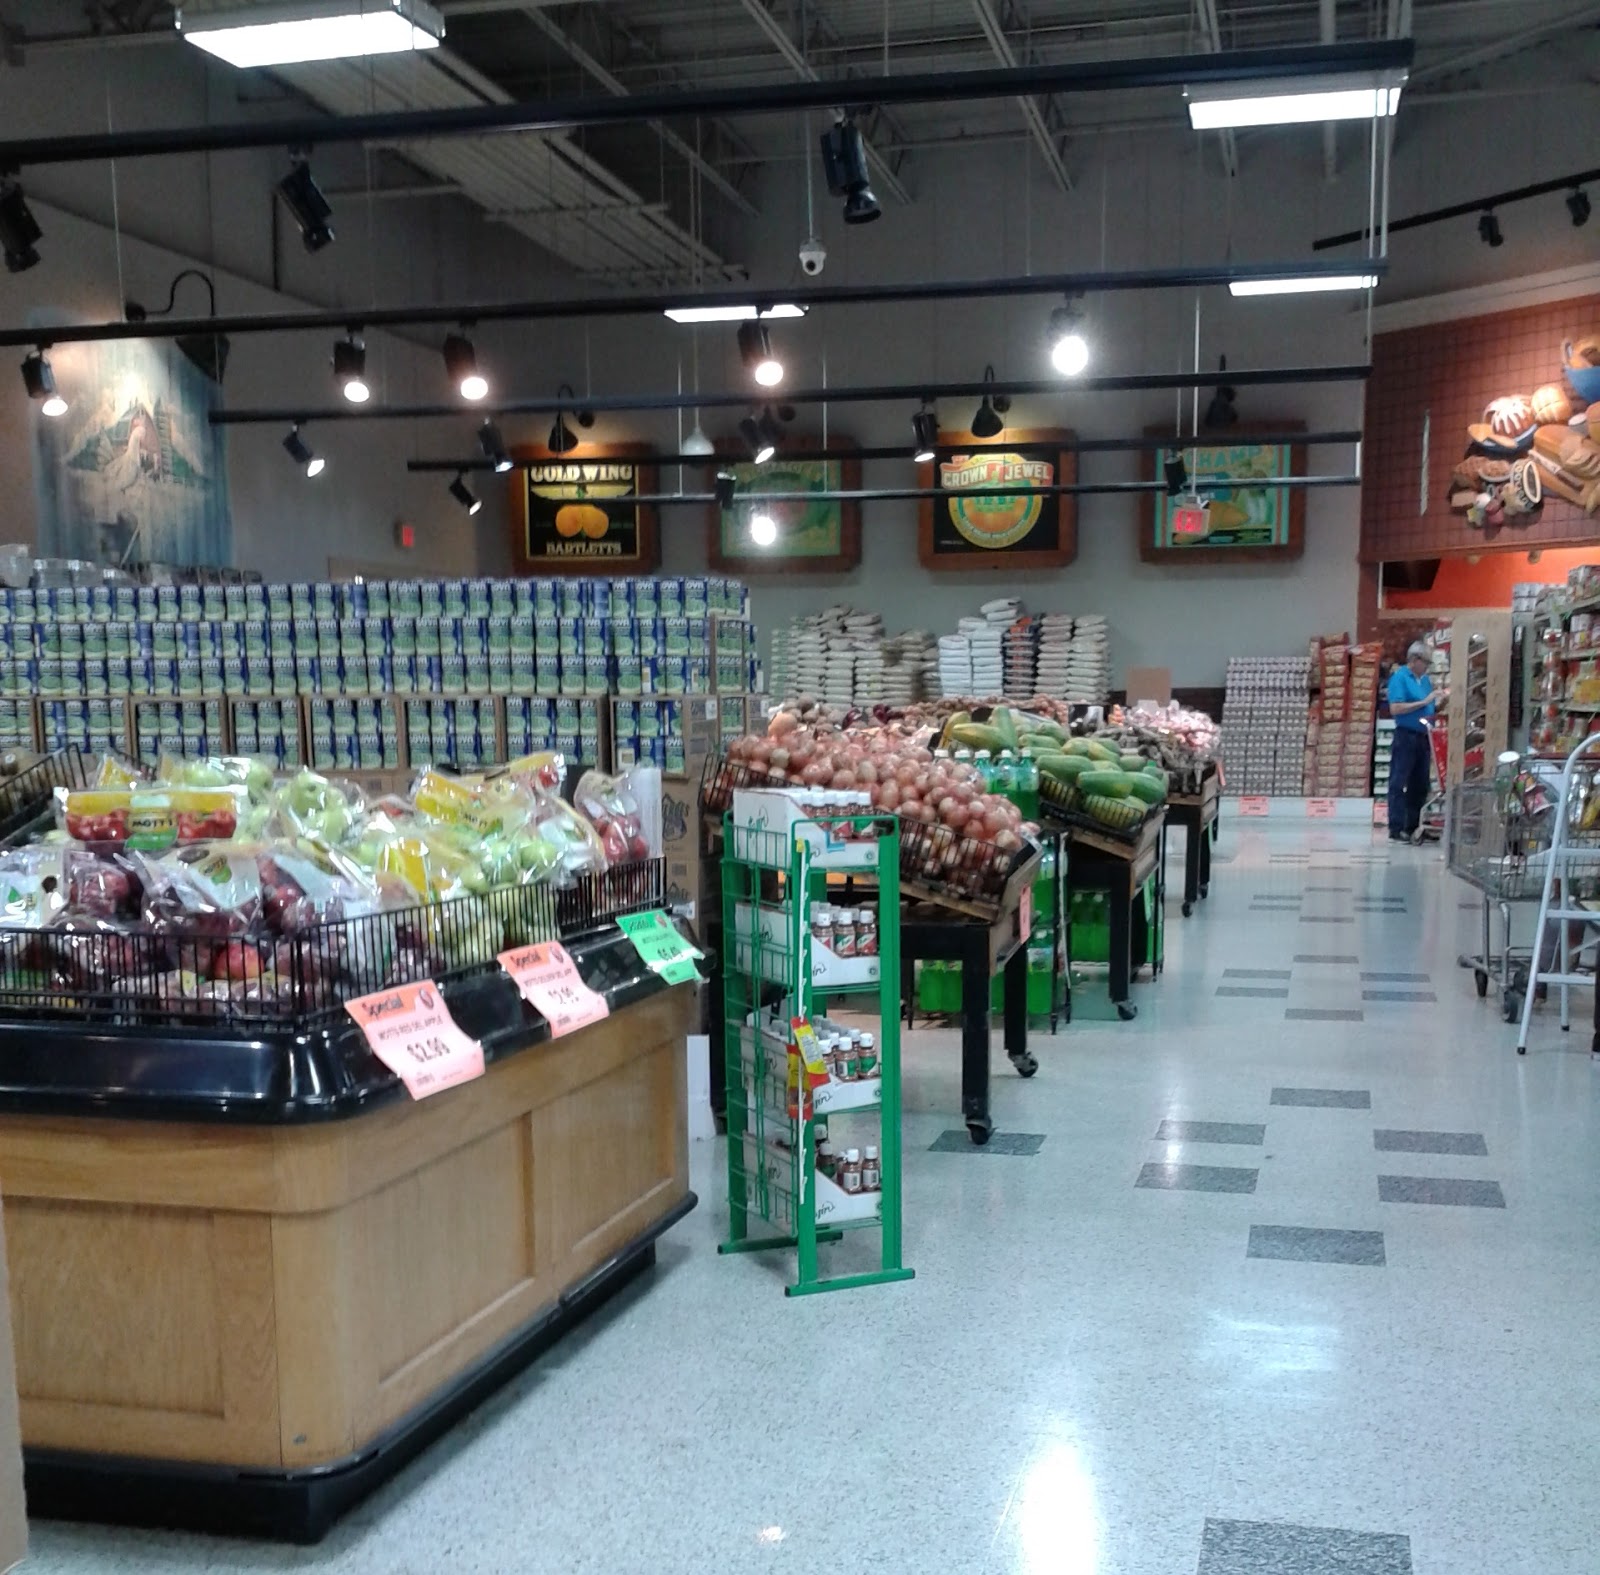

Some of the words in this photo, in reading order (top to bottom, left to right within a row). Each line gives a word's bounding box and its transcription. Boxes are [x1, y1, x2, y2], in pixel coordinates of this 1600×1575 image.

[531, 464, 580, 482] GOLD
[583, 464, 632, 481] WING
[943, 465, 988, 487] CROWN
[1004, 463, 1050, 482] JEWEL
[546, 541, 621, 555] BARTLETTS
